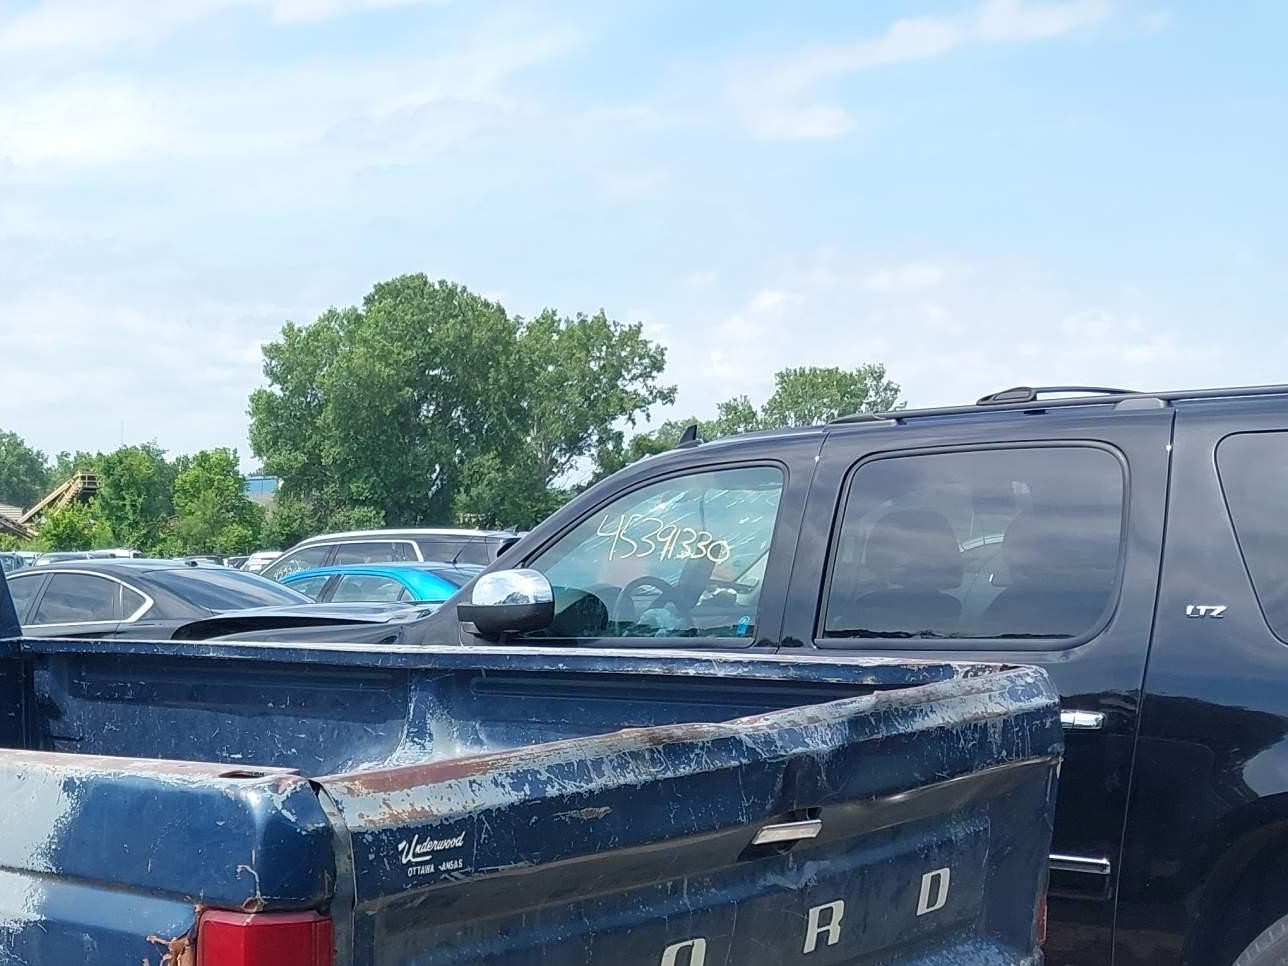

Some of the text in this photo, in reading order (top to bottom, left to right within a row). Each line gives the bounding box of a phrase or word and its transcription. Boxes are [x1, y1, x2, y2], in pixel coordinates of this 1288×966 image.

[597, 513, 730, 563] 45391330
[1186, 605, 1227, 618] LTZ
[398, 831, 467, 865] Underwood
[408, 859, 464, 877] OTTAWA ANSAS
